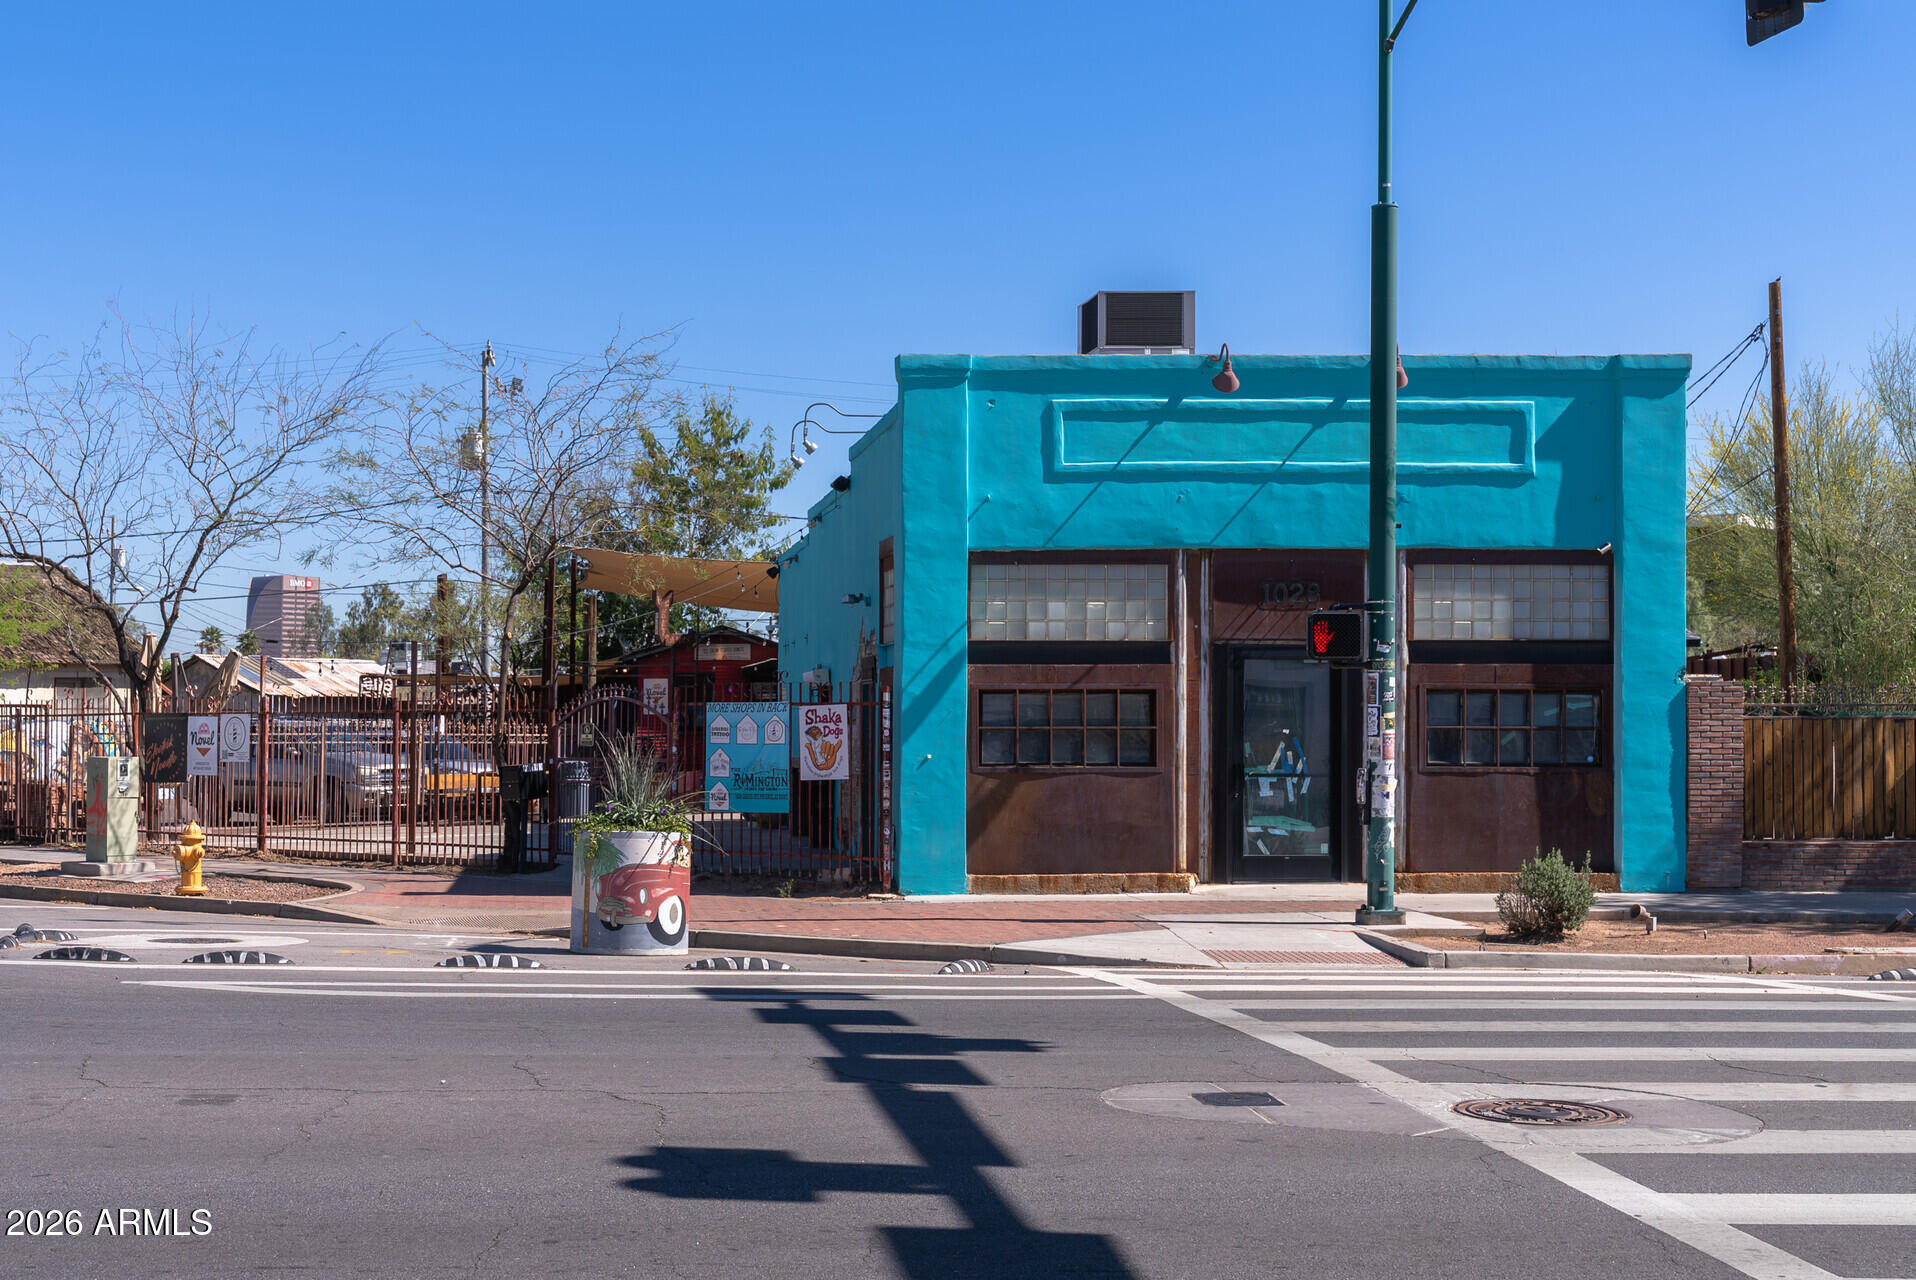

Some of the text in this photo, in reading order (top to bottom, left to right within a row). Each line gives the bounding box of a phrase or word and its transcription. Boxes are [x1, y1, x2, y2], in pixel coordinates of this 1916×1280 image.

[290, 579, 306, 587] BMO
[1263, 582, 1320, 606] 1028
[707, 703, 787, 713] MORE SHOPS IN BACK
[805, 707, 842, 726] Shaka
[190, 730, 215, 746] Novel
